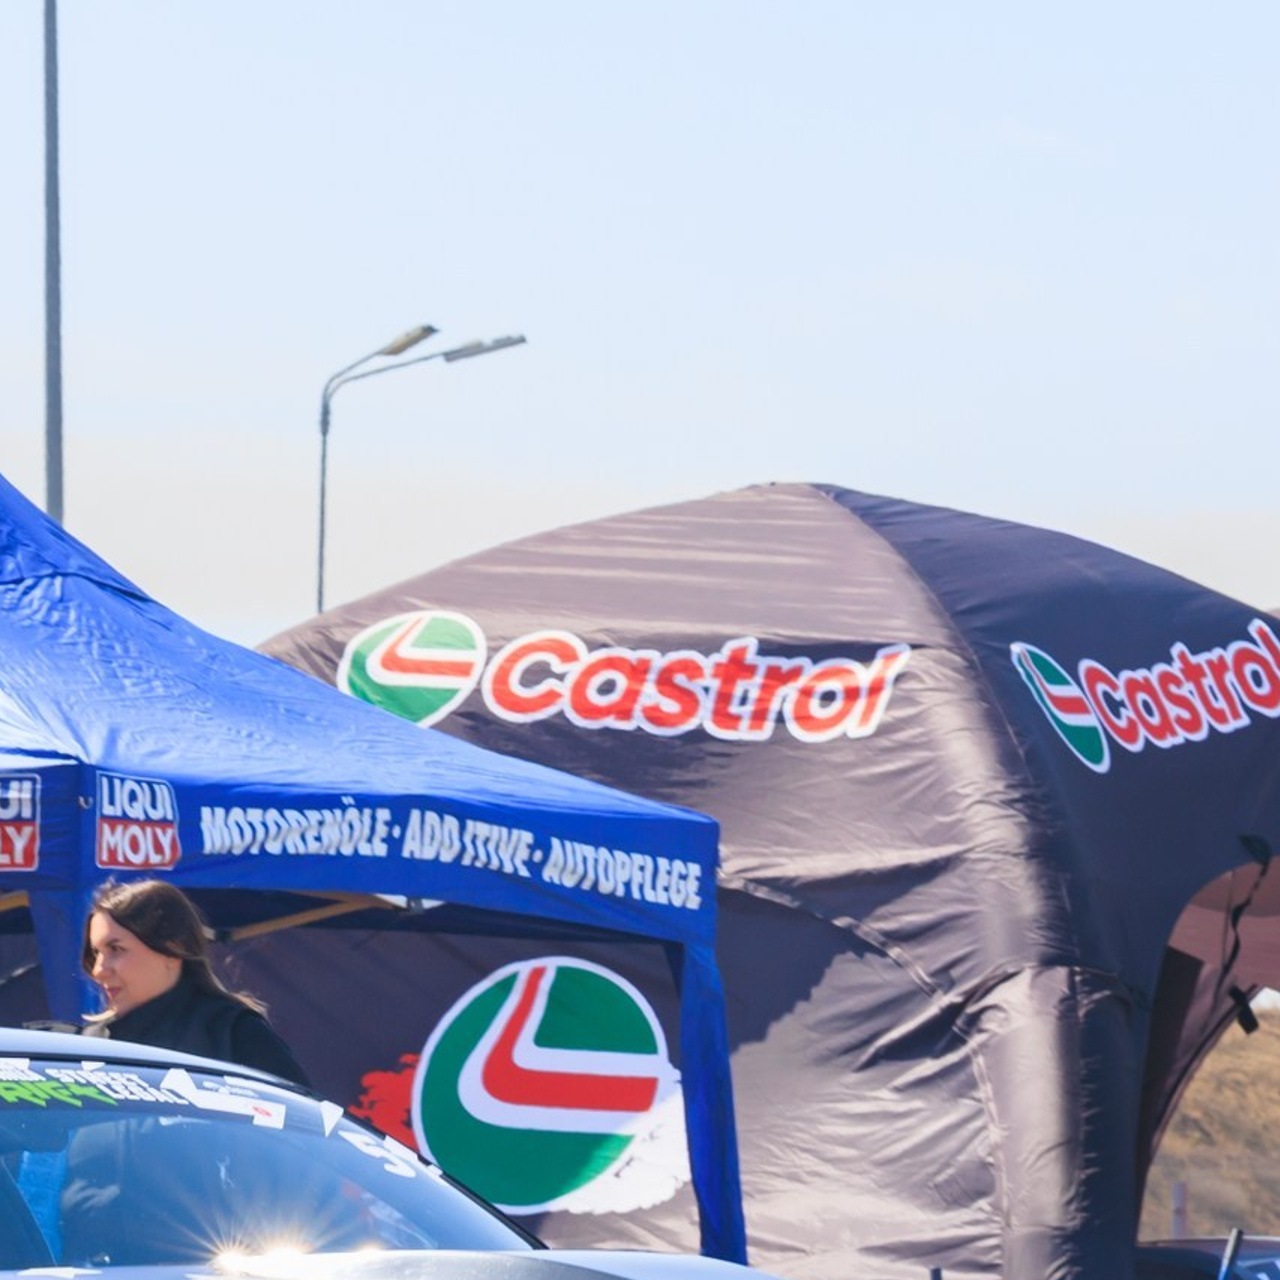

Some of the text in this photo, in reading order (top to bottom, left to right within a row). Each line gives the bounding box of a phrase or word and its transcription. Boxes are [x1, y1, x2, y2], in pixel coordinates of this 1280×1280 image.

[482, 630, 912, 742] Castrol
[100, 775, 174, 820] LIQUI
[100, 823, 175, 867] MOLY
[542, 838, 703, 910] AUTOPFLEGE
